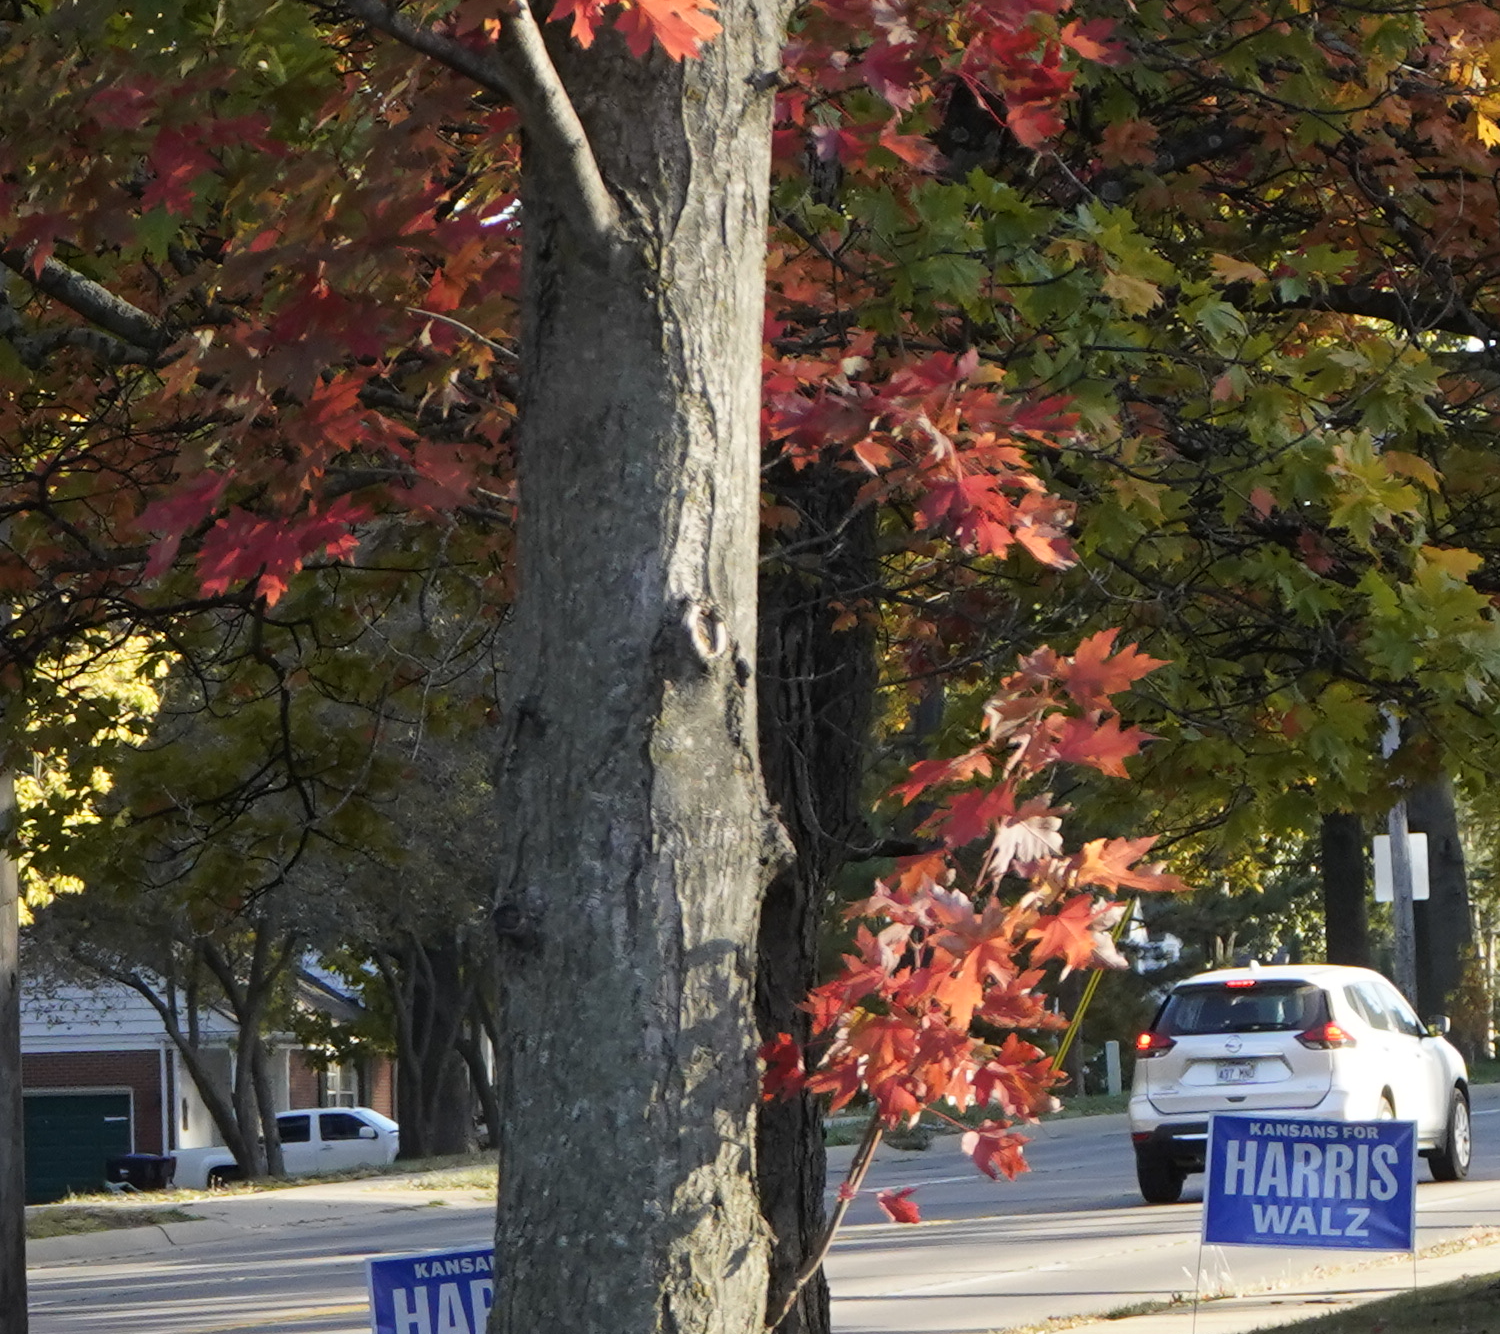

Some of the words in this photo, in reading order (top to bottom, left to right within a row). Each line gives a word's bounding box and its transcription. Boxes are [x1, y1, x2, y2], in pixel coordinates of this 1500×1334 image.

[1249, 1122, 1338, 1139] KANSANS
[1343, 1125, 1379, 1139] FOR
[1223, 1140, 1399, 1201] HARRIS
[1252, 1204, 1371, 1237] WALZ
